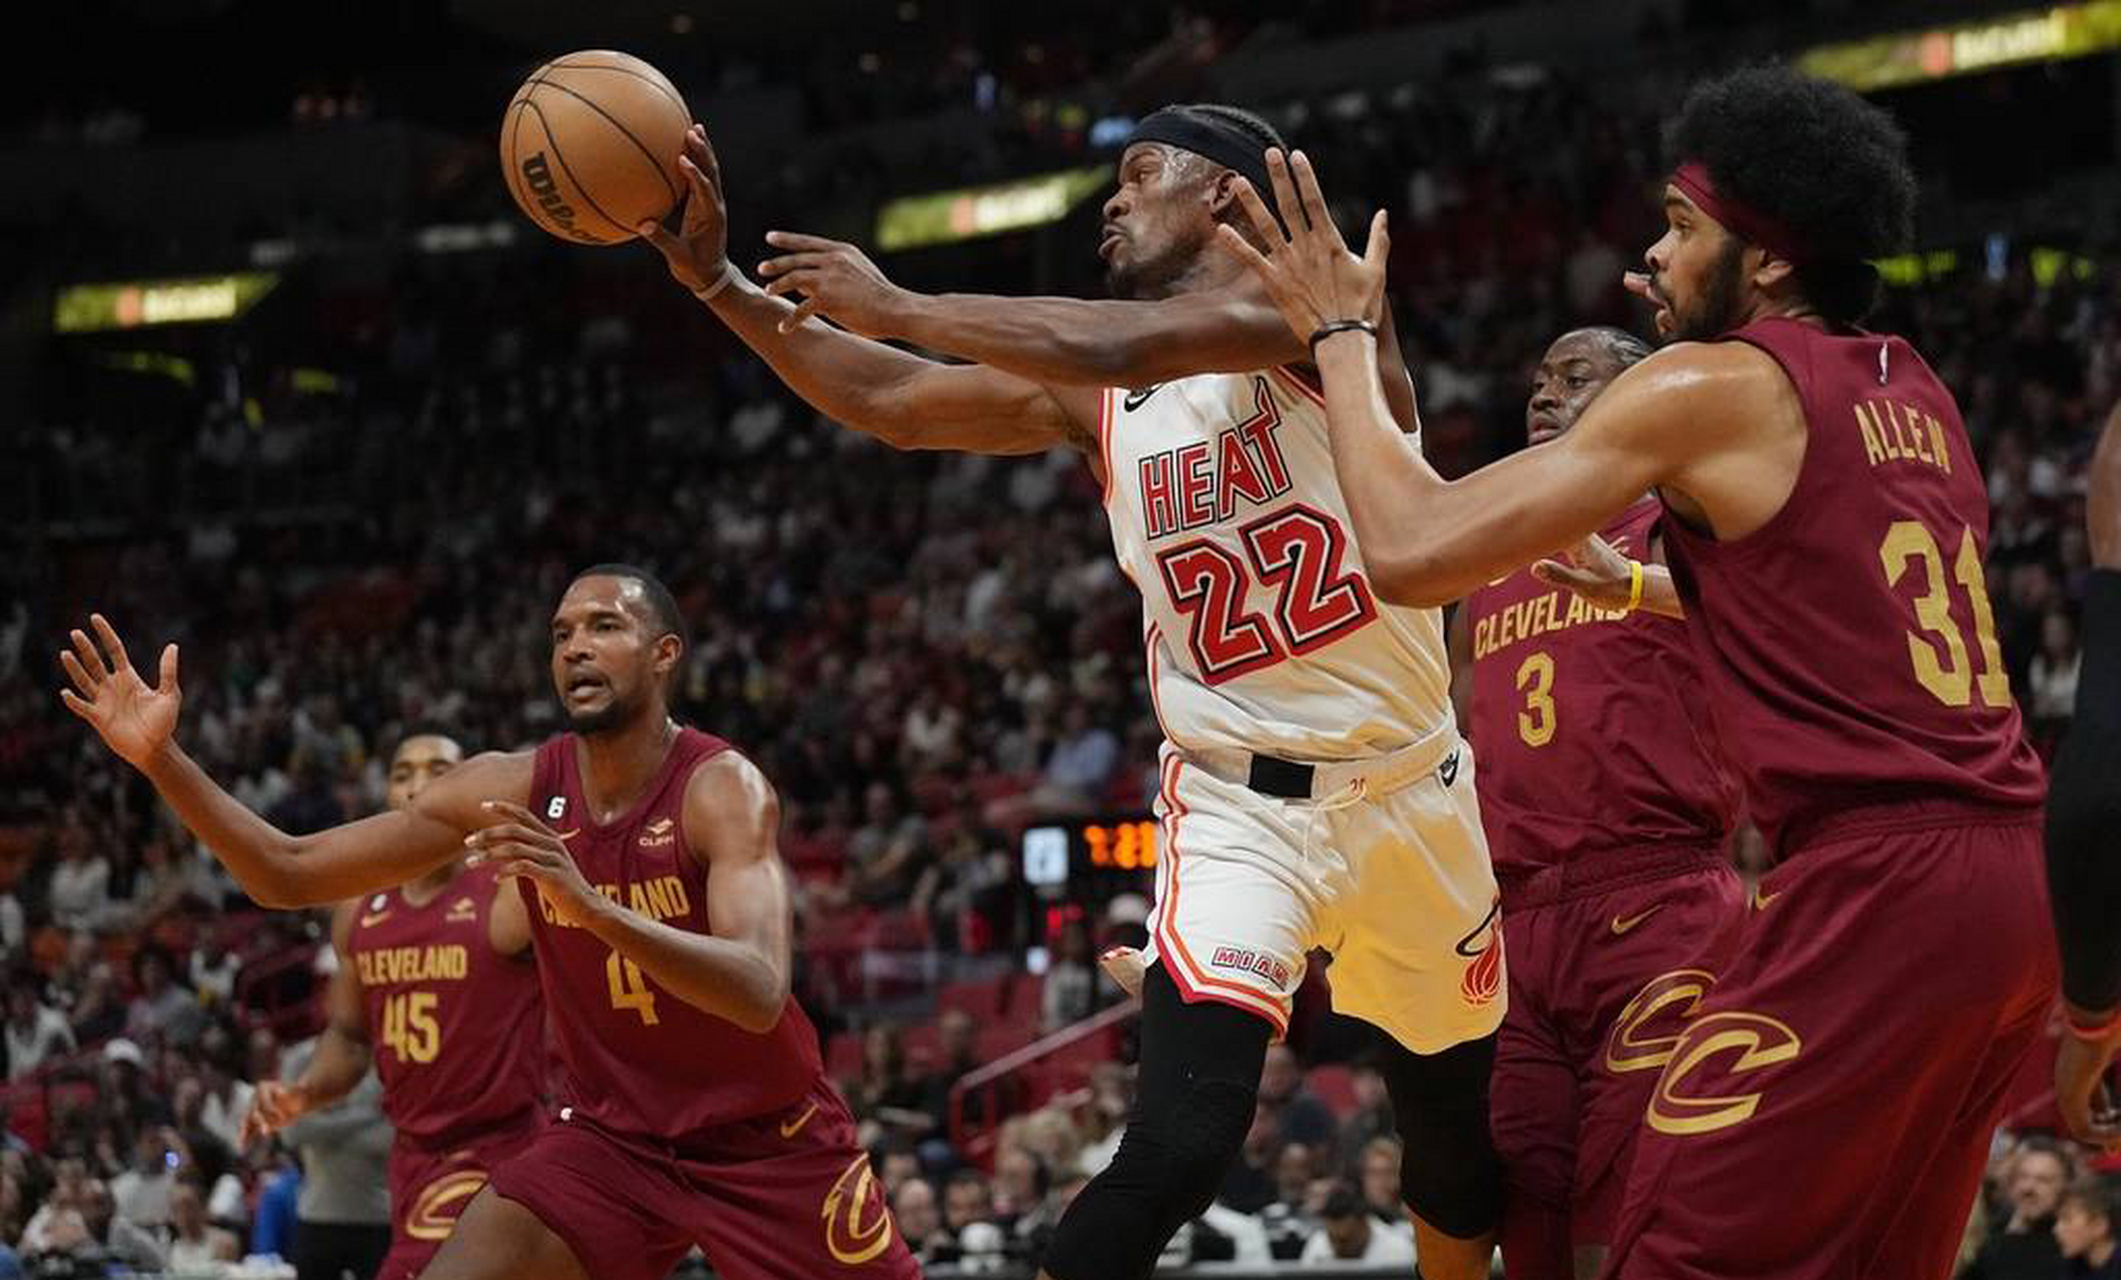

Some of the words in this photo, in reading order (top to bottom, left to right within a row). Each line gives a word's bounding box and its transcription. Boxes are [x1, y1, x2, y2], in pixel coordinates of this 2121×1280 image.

[1139, 375, 1293, 541] HEAT
[1854, 399, 1952, 475] ALLEN
[1154, 501, 1378, 687] 22
[1879, 520, 2012, 708] 31
[1516, 651, 1557, 747] 3
[547, 796, 567, 819] 6
[357, 944, 467, 985] CLEVELAND
[606, 950, 660, 1025] 4
[382, 992, 440, 1063] 45
